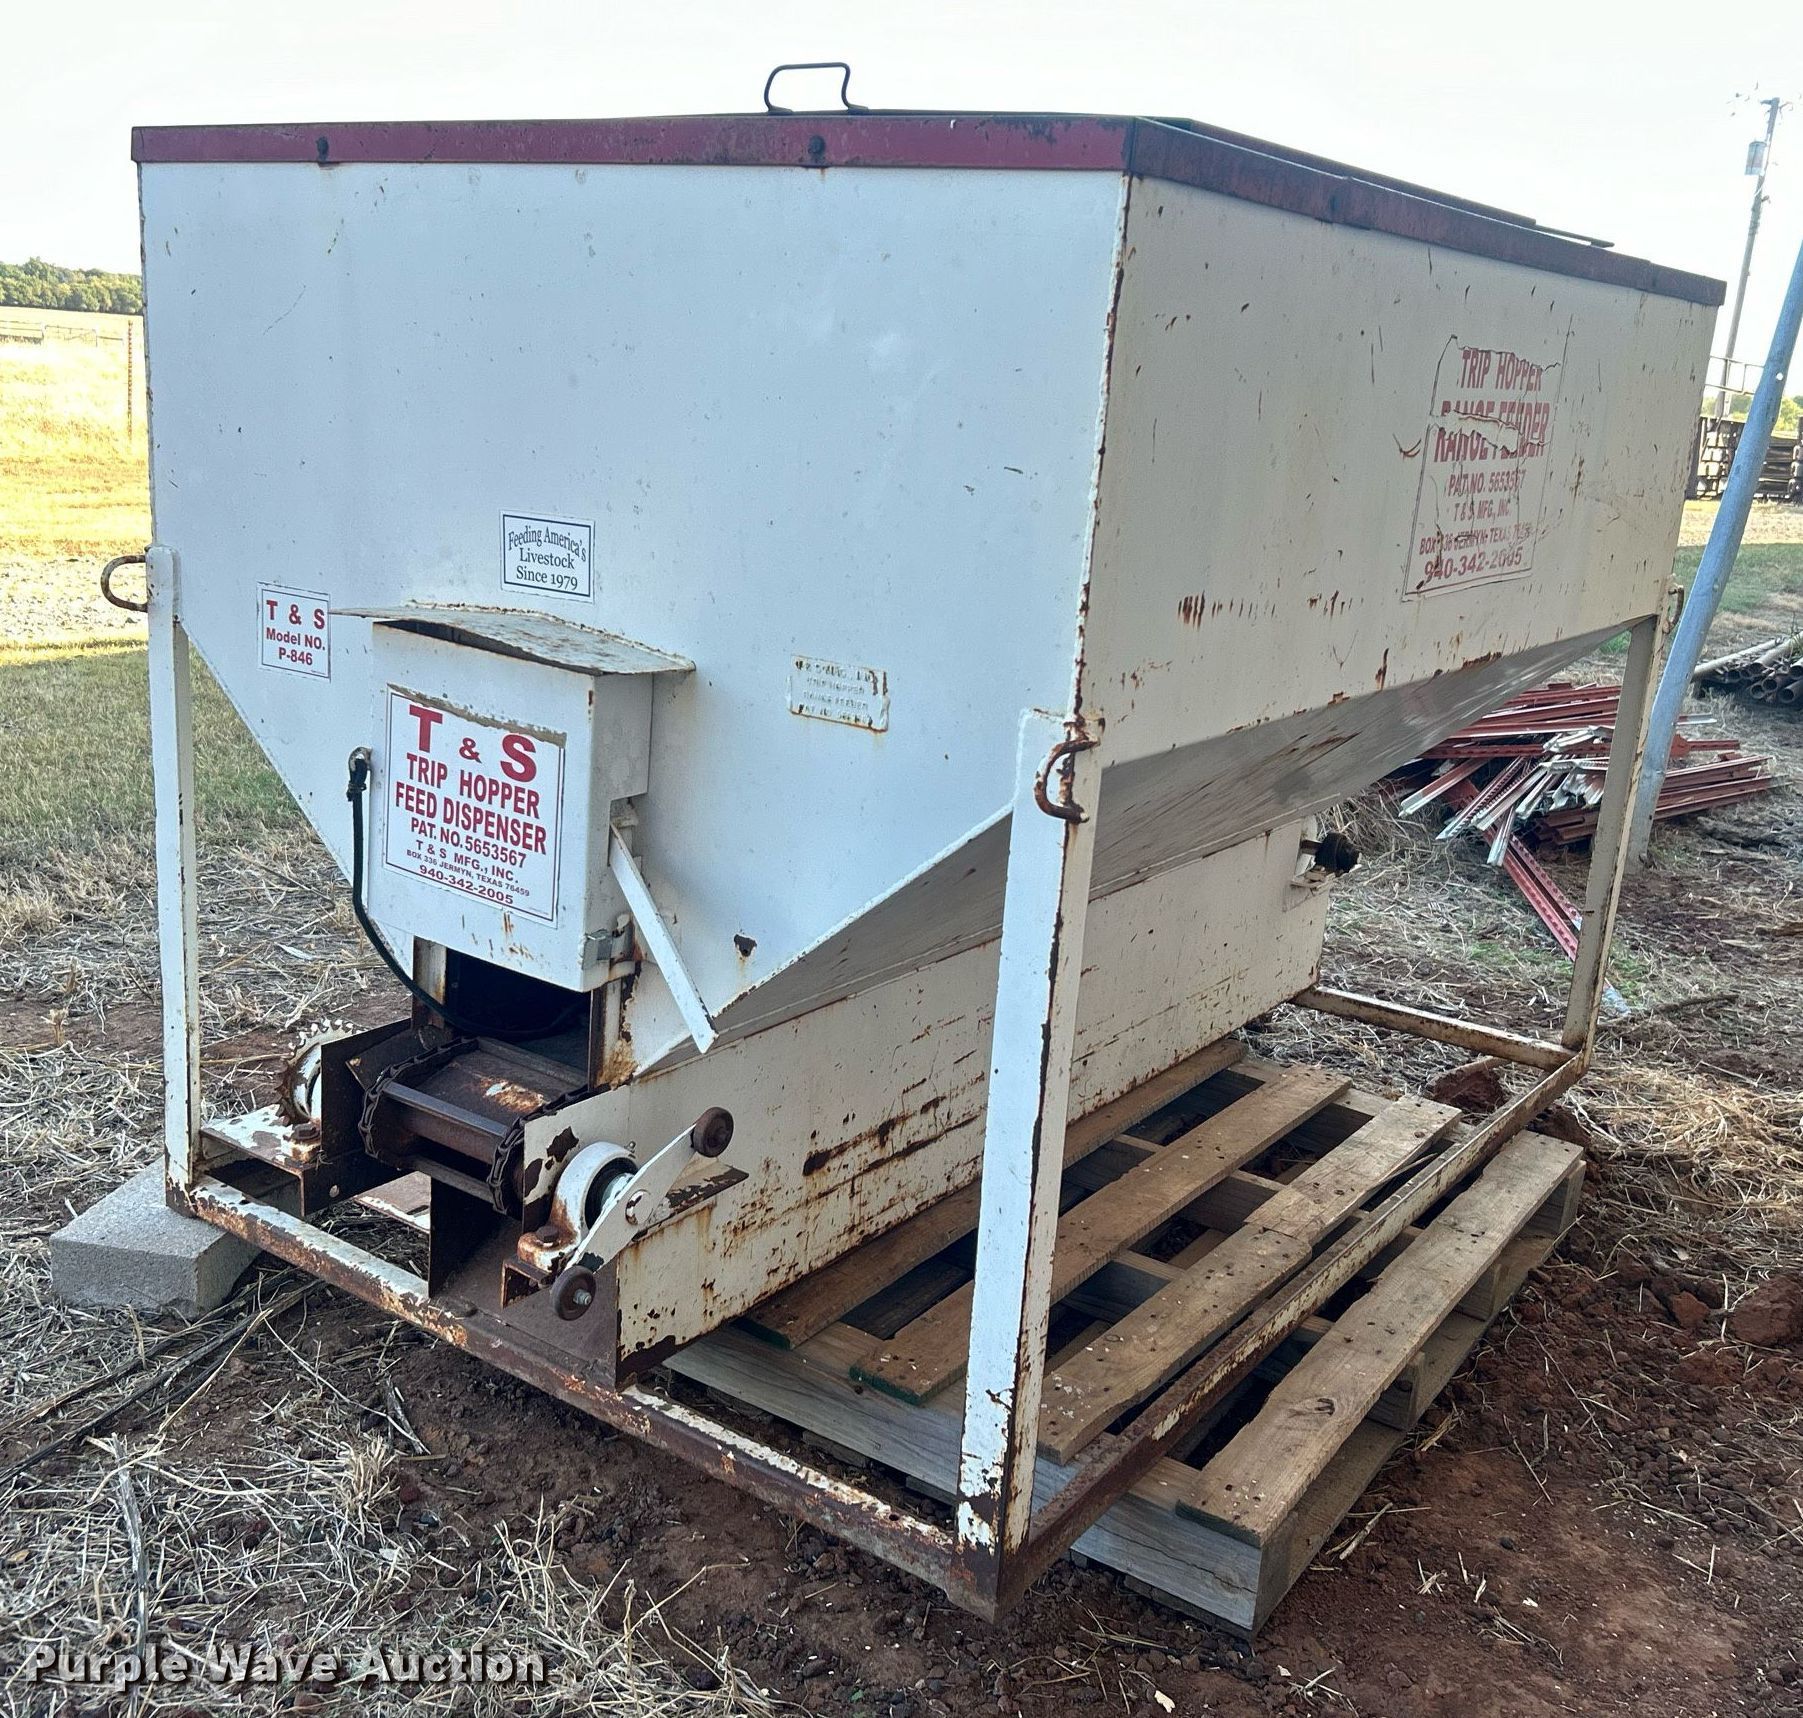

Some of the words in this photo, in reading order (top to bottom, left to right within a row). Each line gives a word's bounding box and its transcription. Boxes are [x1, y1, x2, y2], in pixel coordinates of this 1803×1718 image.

[1460, 348, 1491, 389] TRIP
[508, 525, 543, 551] Feeding
[543, 526, 587, 562] America's
[519, 547, 575, 570] Livestock
[1419, 537, 1436, 556] BOX
[516, 565, 548, 584] Since
[550, 573, 578, 591] 1979
[266, 600, 278, 620] T
[289, 604, 302, 625] &
[313, 608, 326, 630] S
[266, 627, 301, 646] Model
[304, 634, 326, 651] NO.
[278, 647, 313, 666] P-846
[409, 704, 444, 753] T
[459, 737, 483, 763] &
[500, 734, 537, 783] S
[406, 753, 448, 789] TRIP
[459, 770, 540, 819] HOPPER
[395, 781, 437, 819] FEED
[443, 797, 547, 855] DISPENSER
[406, 849, 422, 860] BOX
[424, 855, 438, 866] 336
[439, 861, 474, 879] JERMYN,
[476, 873, 503, 888] TEXAS
[416, 840, 424, 851] T
[427, 844, 435, 855] &
[439, 848, 447, 859] S
[491, 865, 519, 884] INC.
[419, 864, 514, 905] 940-342-2005
